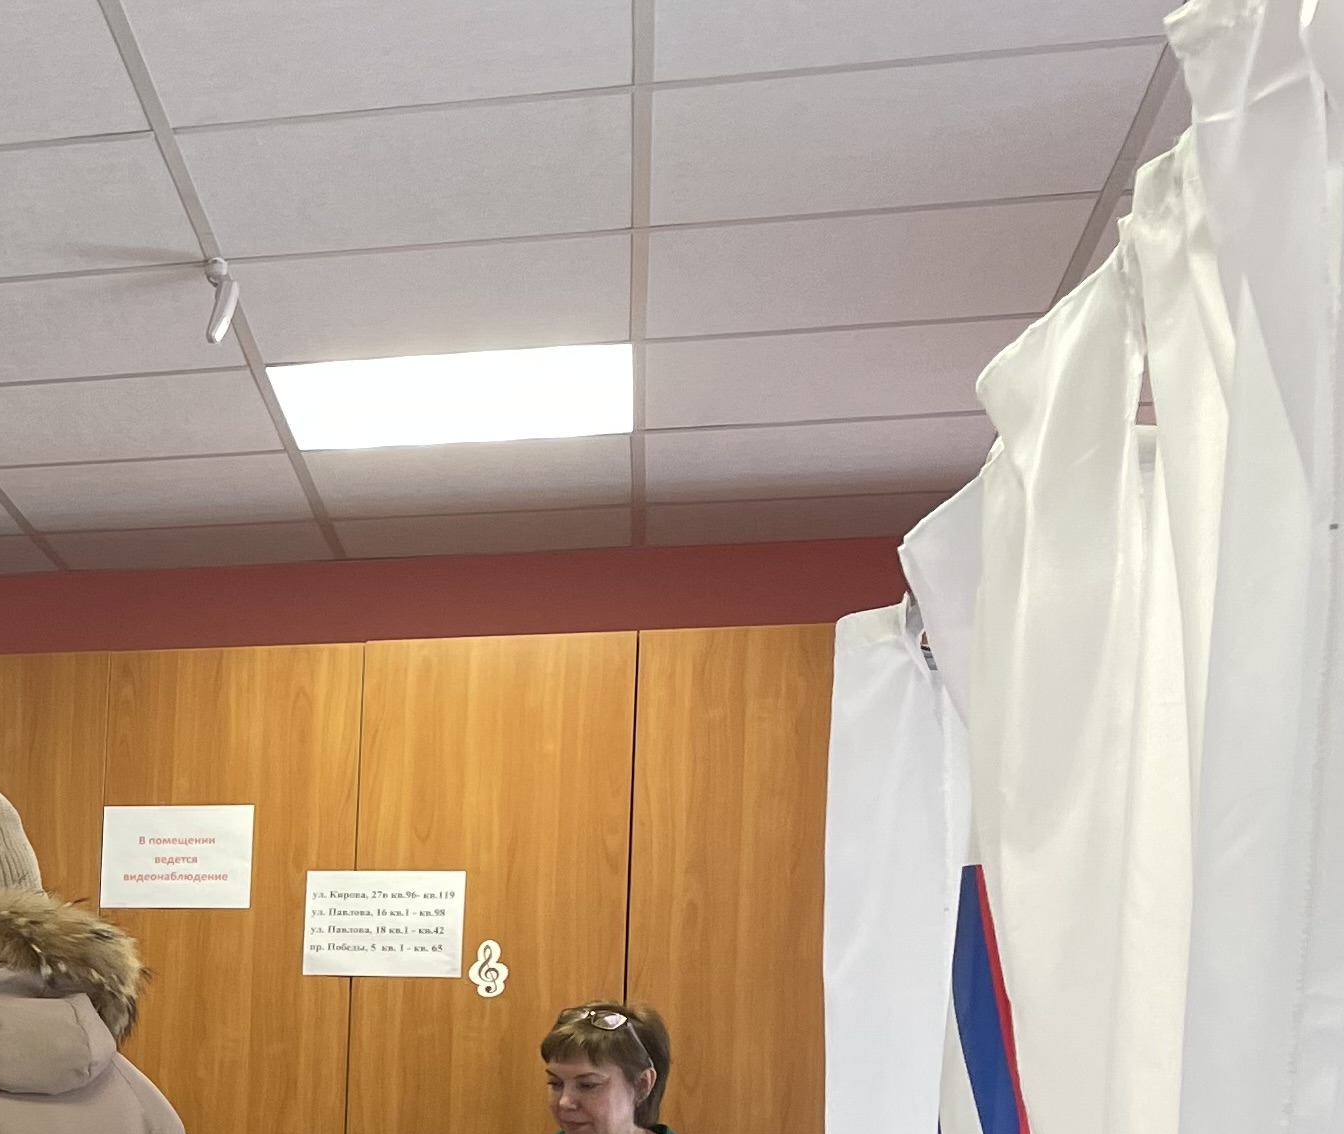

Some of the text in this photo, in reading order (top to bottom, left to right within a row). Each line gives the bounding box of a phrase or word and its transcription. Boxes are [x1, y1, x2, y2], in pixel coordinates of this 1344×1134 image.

[138, 836, 216, 846] В помещении
[154, 856, 198, 866] ведется
[123, 871, 229, 883] видеонаблюдение
[330, 890, 369, 900] Кирова,
[328, 908, 374, 917] Павлова,
[327, 926, 373, 935] Павлова,
[327, 943, 369, 952] Победы,
